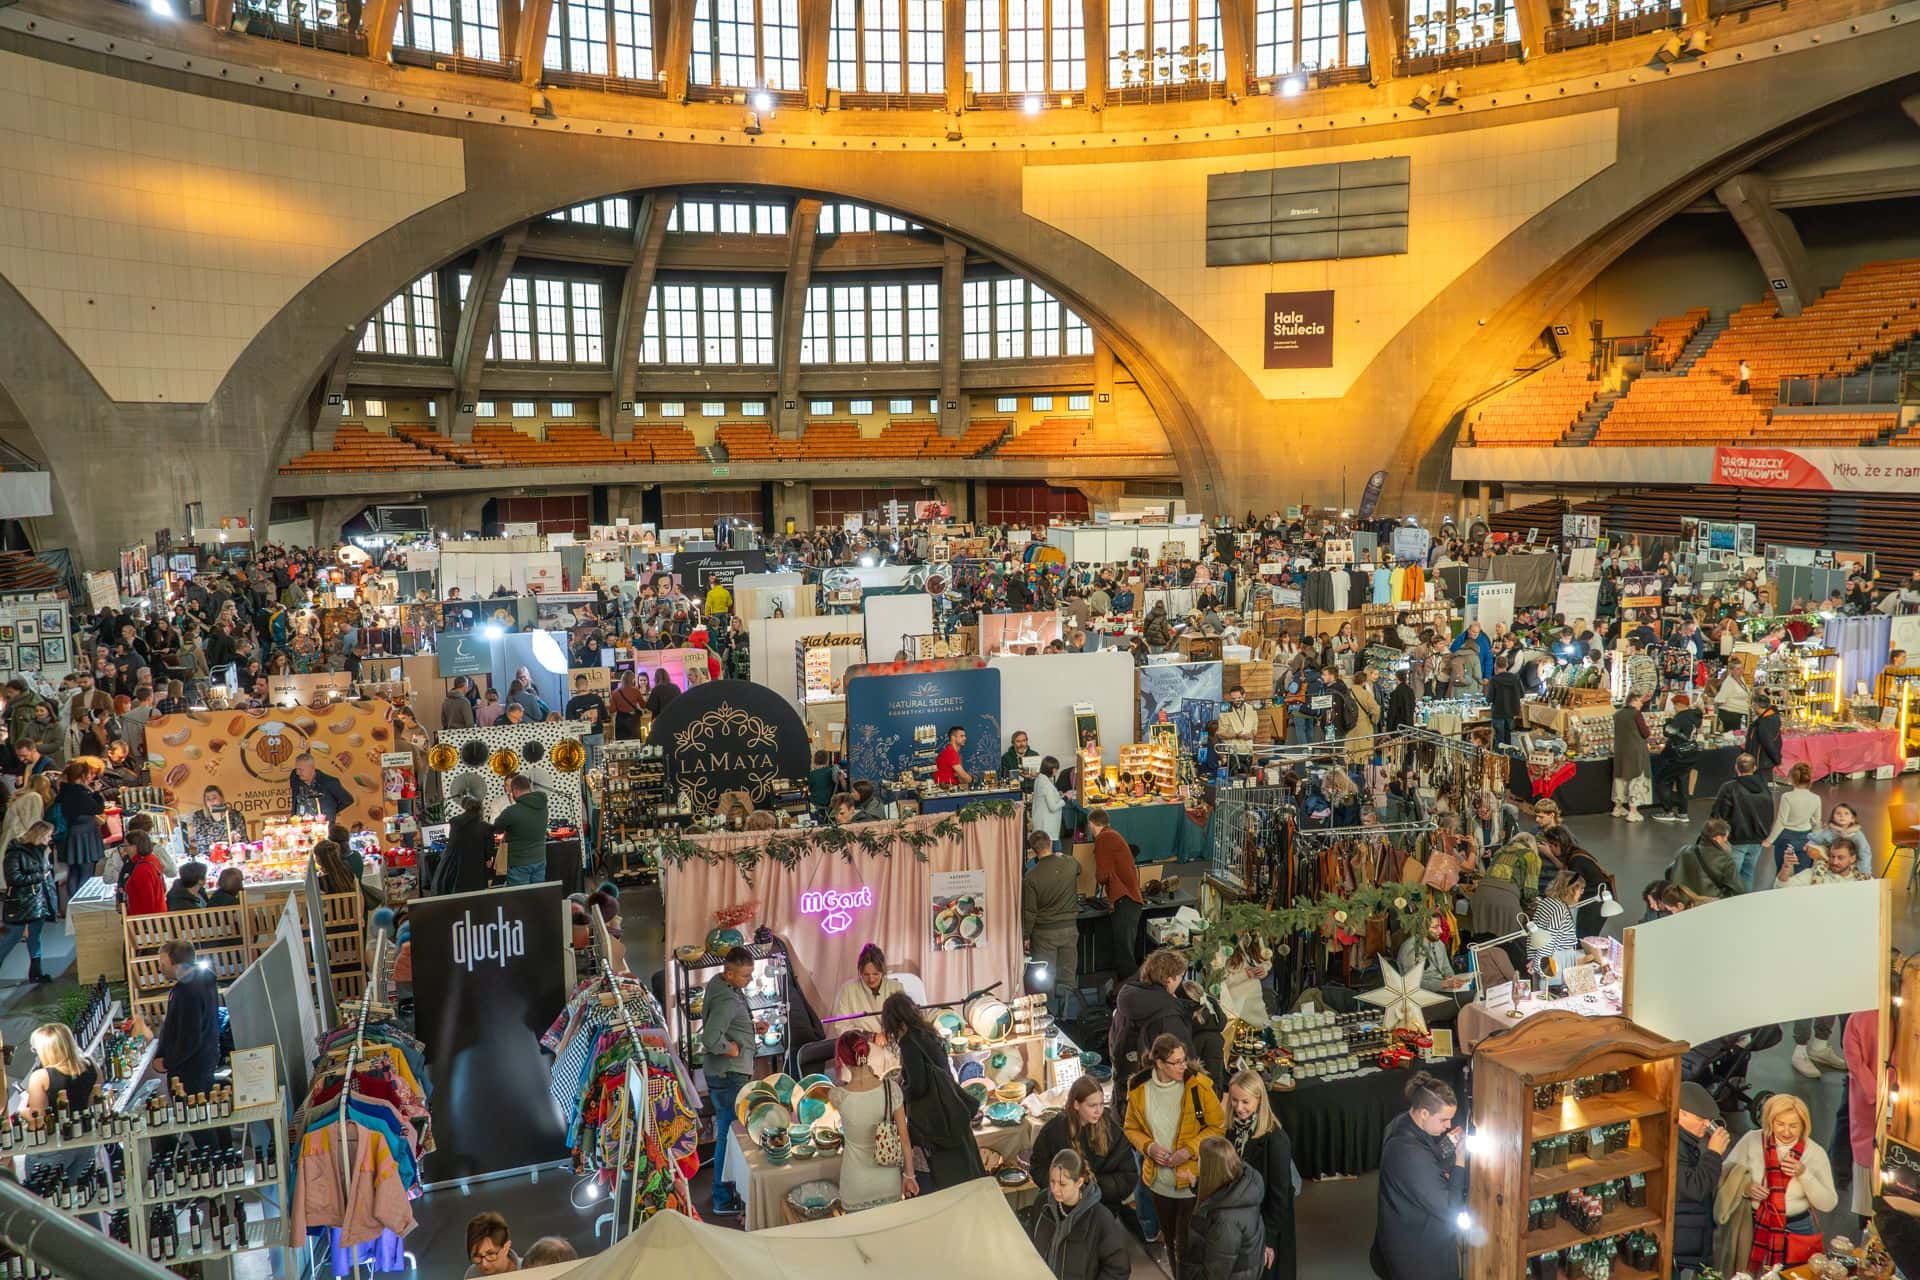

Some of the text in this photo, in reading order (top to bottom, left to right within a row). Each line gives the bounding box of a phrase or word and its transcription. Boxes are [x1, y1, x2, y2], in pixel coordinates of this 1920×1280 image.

[1274, 311, 1304, 324] Hala
[1274, 322, 1325, 336] Stulecia
[1749, 457, 1784, 468] RZECZY
[1833, 463, 1861, 477] Miło,
[1864, 463, 1881, 477] że
[1884, 468, 1892, 477] z
[889, 696, 965, 709] NATURAL SECRETS
